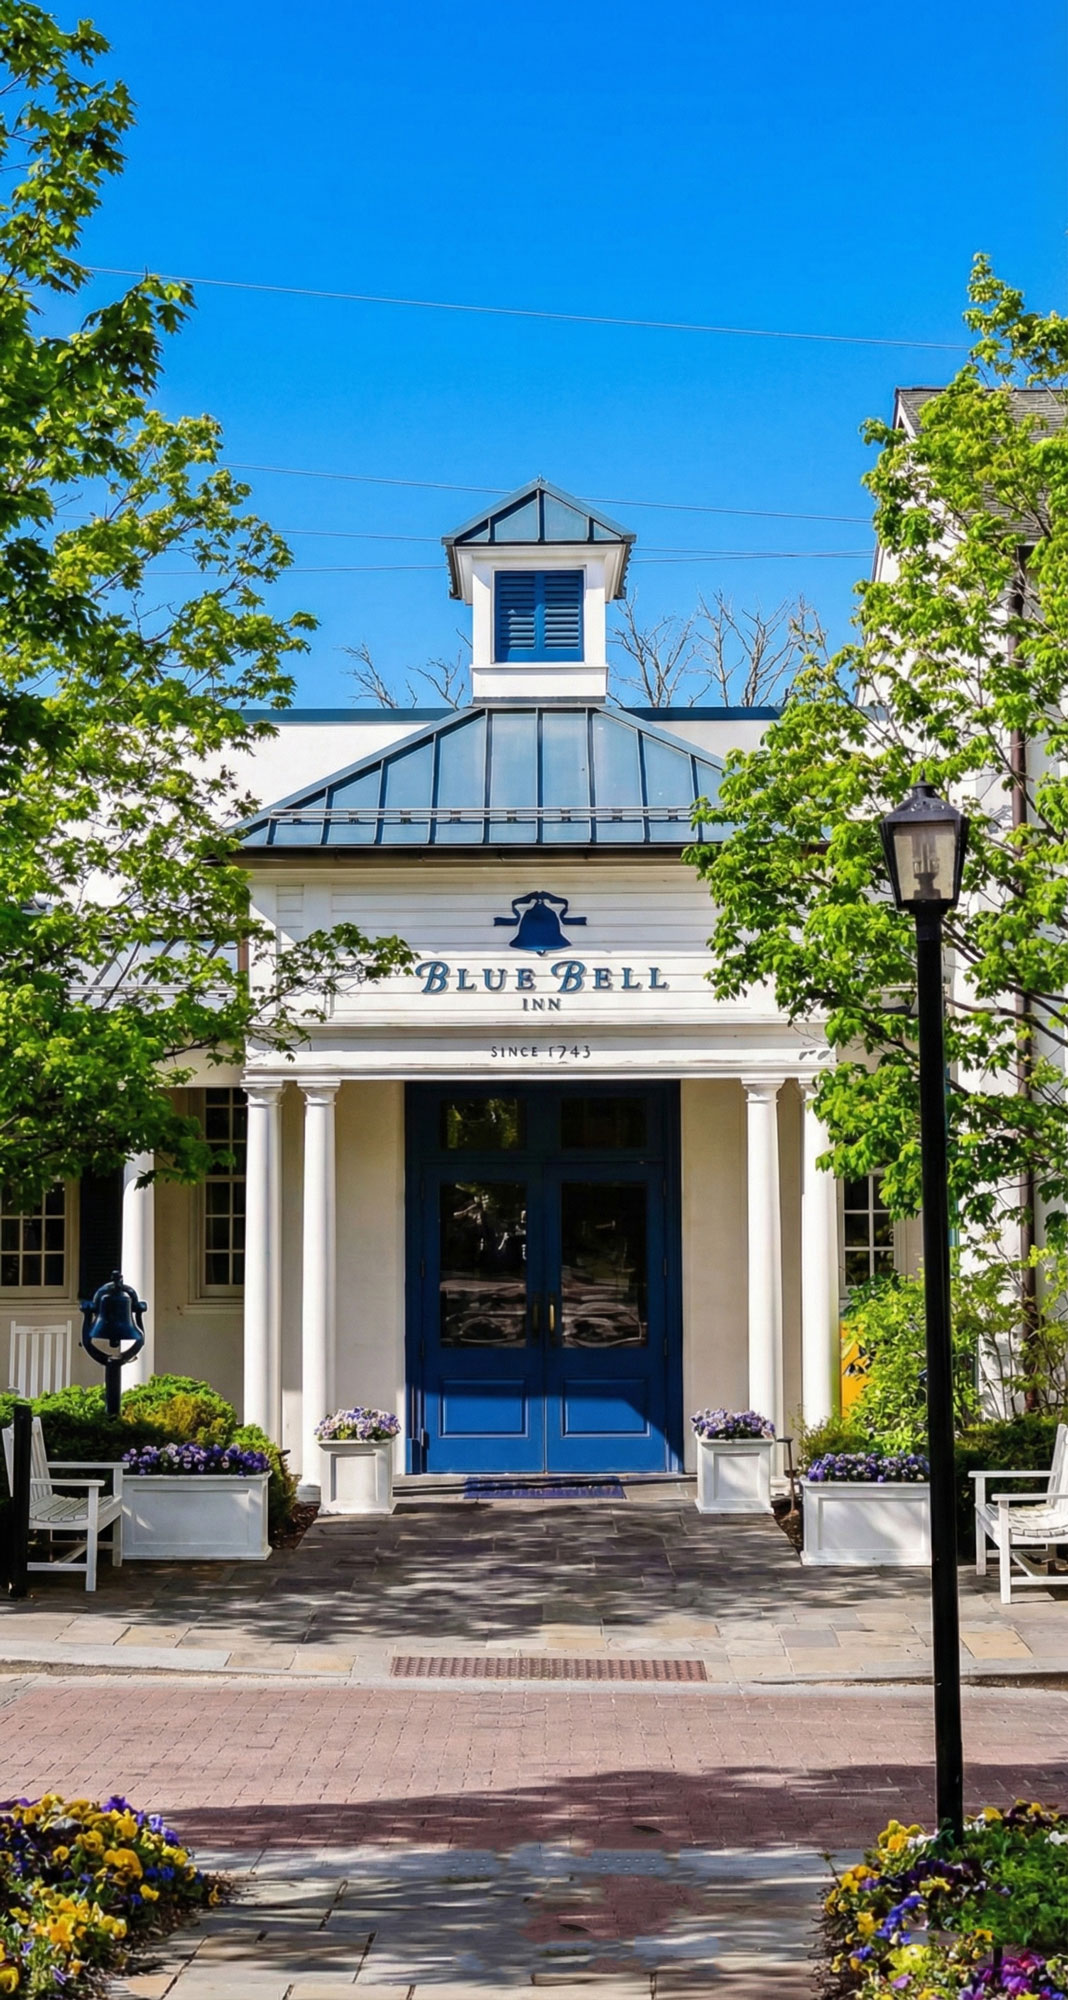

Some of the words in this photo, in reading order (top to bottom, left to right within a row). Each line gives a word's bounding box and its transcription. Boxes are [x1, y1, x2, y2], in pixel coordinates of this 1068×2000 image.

[415, 961, 536, 993] BLUE
[551, 960, 668, 993] BELL
[522, 998, 562, 1011] INN
[490, 1046, 538, 1058] SINCE
[548, 1045, 591, 1059] 1743
